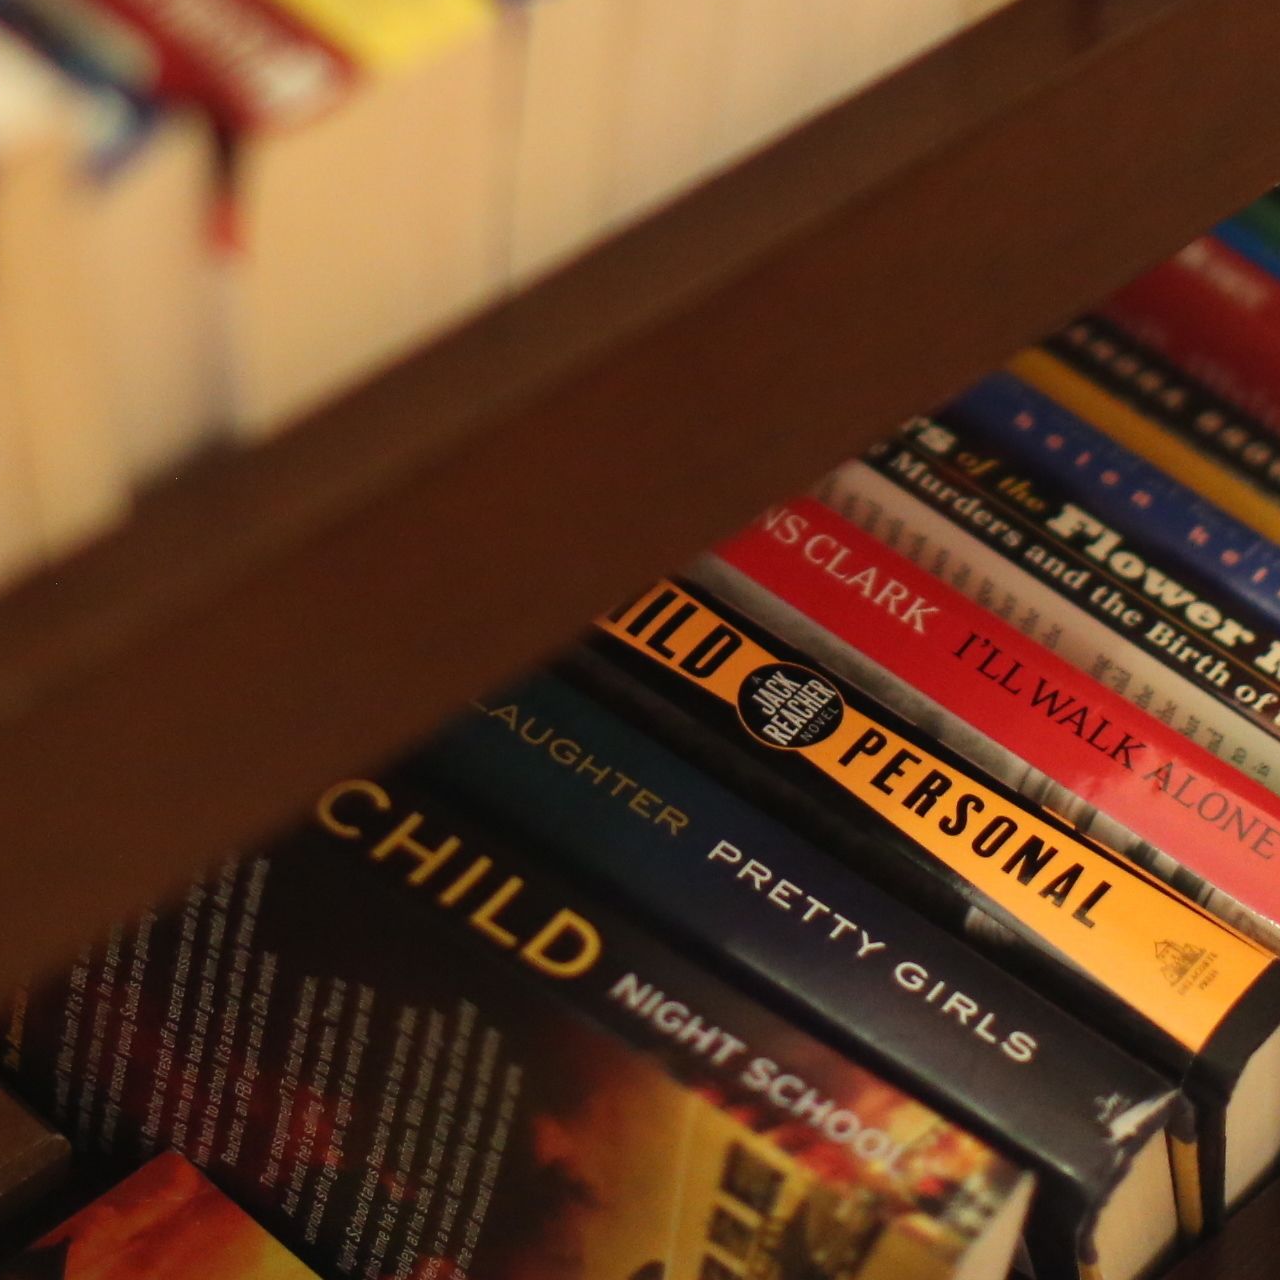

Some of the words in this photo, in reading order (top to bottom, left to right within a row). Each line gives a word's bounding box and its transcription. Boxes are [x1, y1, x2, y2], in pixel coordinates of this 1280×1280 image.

[953, 447, 993, 481] of
[995, 472, 1048, 514] the
[1046, 500, 1256, 650] Flower
[889, 450, 1020, 556] Murders
[1023, 540, 1090, 597] and
[1086, 582, 1141, 635] the
[1144, 617, 1233, 688] Birth
[1234, 682, 1280, 714] of
[798, 525, 940, 639] CLARK
[951, 628, 1023, 701] I'LL
[1026, 678, 1149, 773] WALK
[751, 669, 805, 720] JACK
[763, 678, 836, 749] REACHER
[799, 704, 841, 744] NOVEL
[608, 588, 743, 679] ILD
[835, 725, 1118, 930] PERSONAL
[472, 698, 691, 839] AUGHTER
[708, 838, 889, 959] PRETTY
[892, 959, 1042, 1065] GIRLS
[132, 955, 146, 979] are
[314, 775, 604, 980] CHILD
[607, 970, 748, 1070] NIGHT
[741, 1054, 920, 1181] SCHOOL
[122, 977, 142, 1019] Saudis
[165, 980, 185, 1020] secret
[196, 977, 218, 1012] gives
[252, 988, 269, 1013] CIA
[192, 1008, 209, 1033] and
[220, 993, 241, 1034] school
[119, 1018, 138, 1055] young
[160, 1026, 176, 1047] off
[186, 1032, 204, 1061] back
[214, 1040, 231, 1062] It's
[245, 1020, 263, 1046] and
[154, 1045, 173, 1078] fresh
[182, 1061, 199, 1082] the
[239, 1042, 262, 1079] agent
[206, 1062, 227, 1104] school.
[234, 1076, 252, 1100] FBI
[308, 1070, 326, 1096] And
[142, 1089, 164, 1138] Reacher
[175, 1097, 192, 1120] him
[267, 1086, 297, 1159] assignment?
[331, 1090, 354, 1126] signs
[198, 1115, 216, 1145] back
[221, 1113, 246, 1166] Reacher,
[294, 1132, 313, 1160] he's
[365, 1116, 389, 1166] Reacher
[193, 1143, 211, 1167] him
[260, 1156, 279, 1187] Their
[319, 1141, 342, 1178] going
[288, 1158, 307, 1191] what
[314, 1173, 332, 1200] shit
[357, 1164, 378, 1200] takes
[386, 1177, 404, 1201] not
[282, 1190, 300, 1217] And
[346, 1195, 370, 1242] School
[379, 1200, 398, 1231] he's
[407, 1210, 424, 1230] his
[304, 1199, 326, 1245] serious
[339, 1238, 362, 1274] Night
[372, 1228, 391, 1257] time
